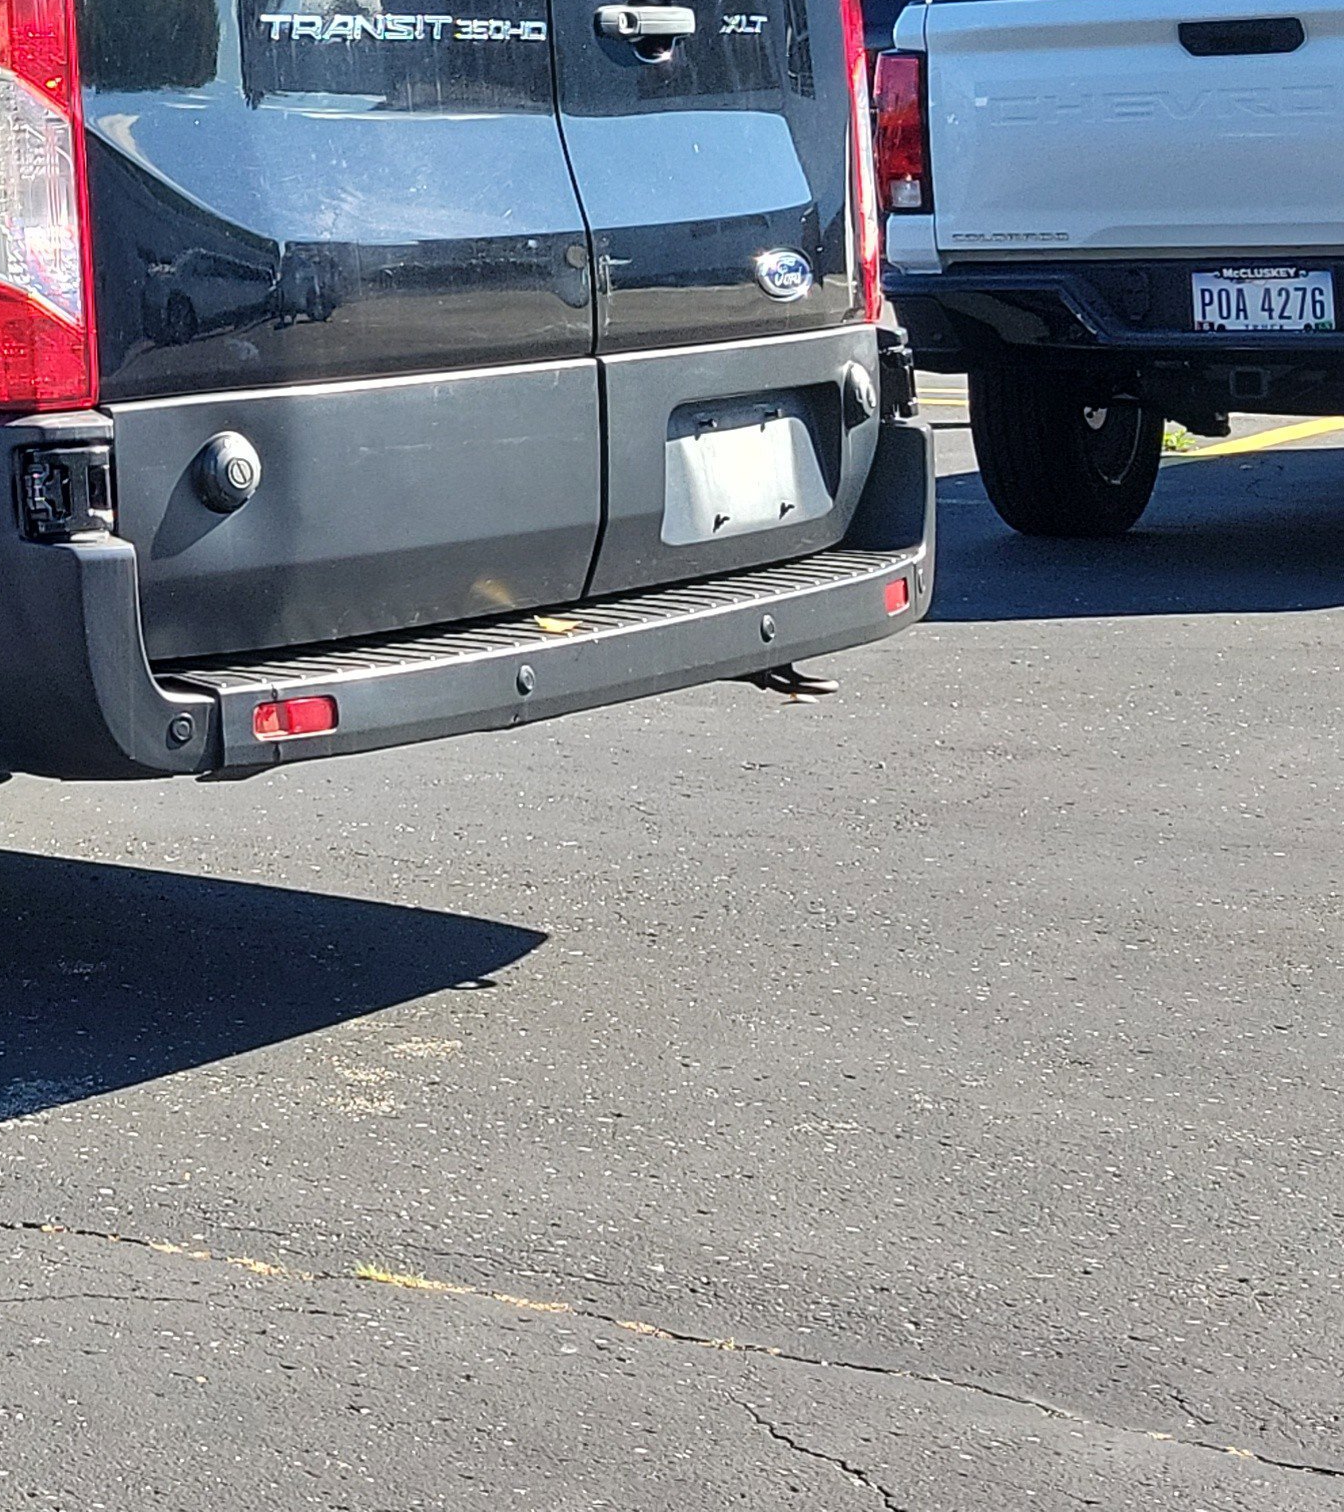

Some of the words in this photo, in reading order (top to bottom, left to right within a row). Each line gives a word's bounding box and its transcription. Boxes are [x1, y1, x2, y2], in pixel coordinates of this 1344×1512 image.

[260, 14, 452, 40] TRANSIT
[718, 14, 768, 34] XLT
[1222, 267, 1297, 279] McCLUSKEY
[1199, 287, 1250, 321] POA
[1260, 286, 1326, 321] 4276
